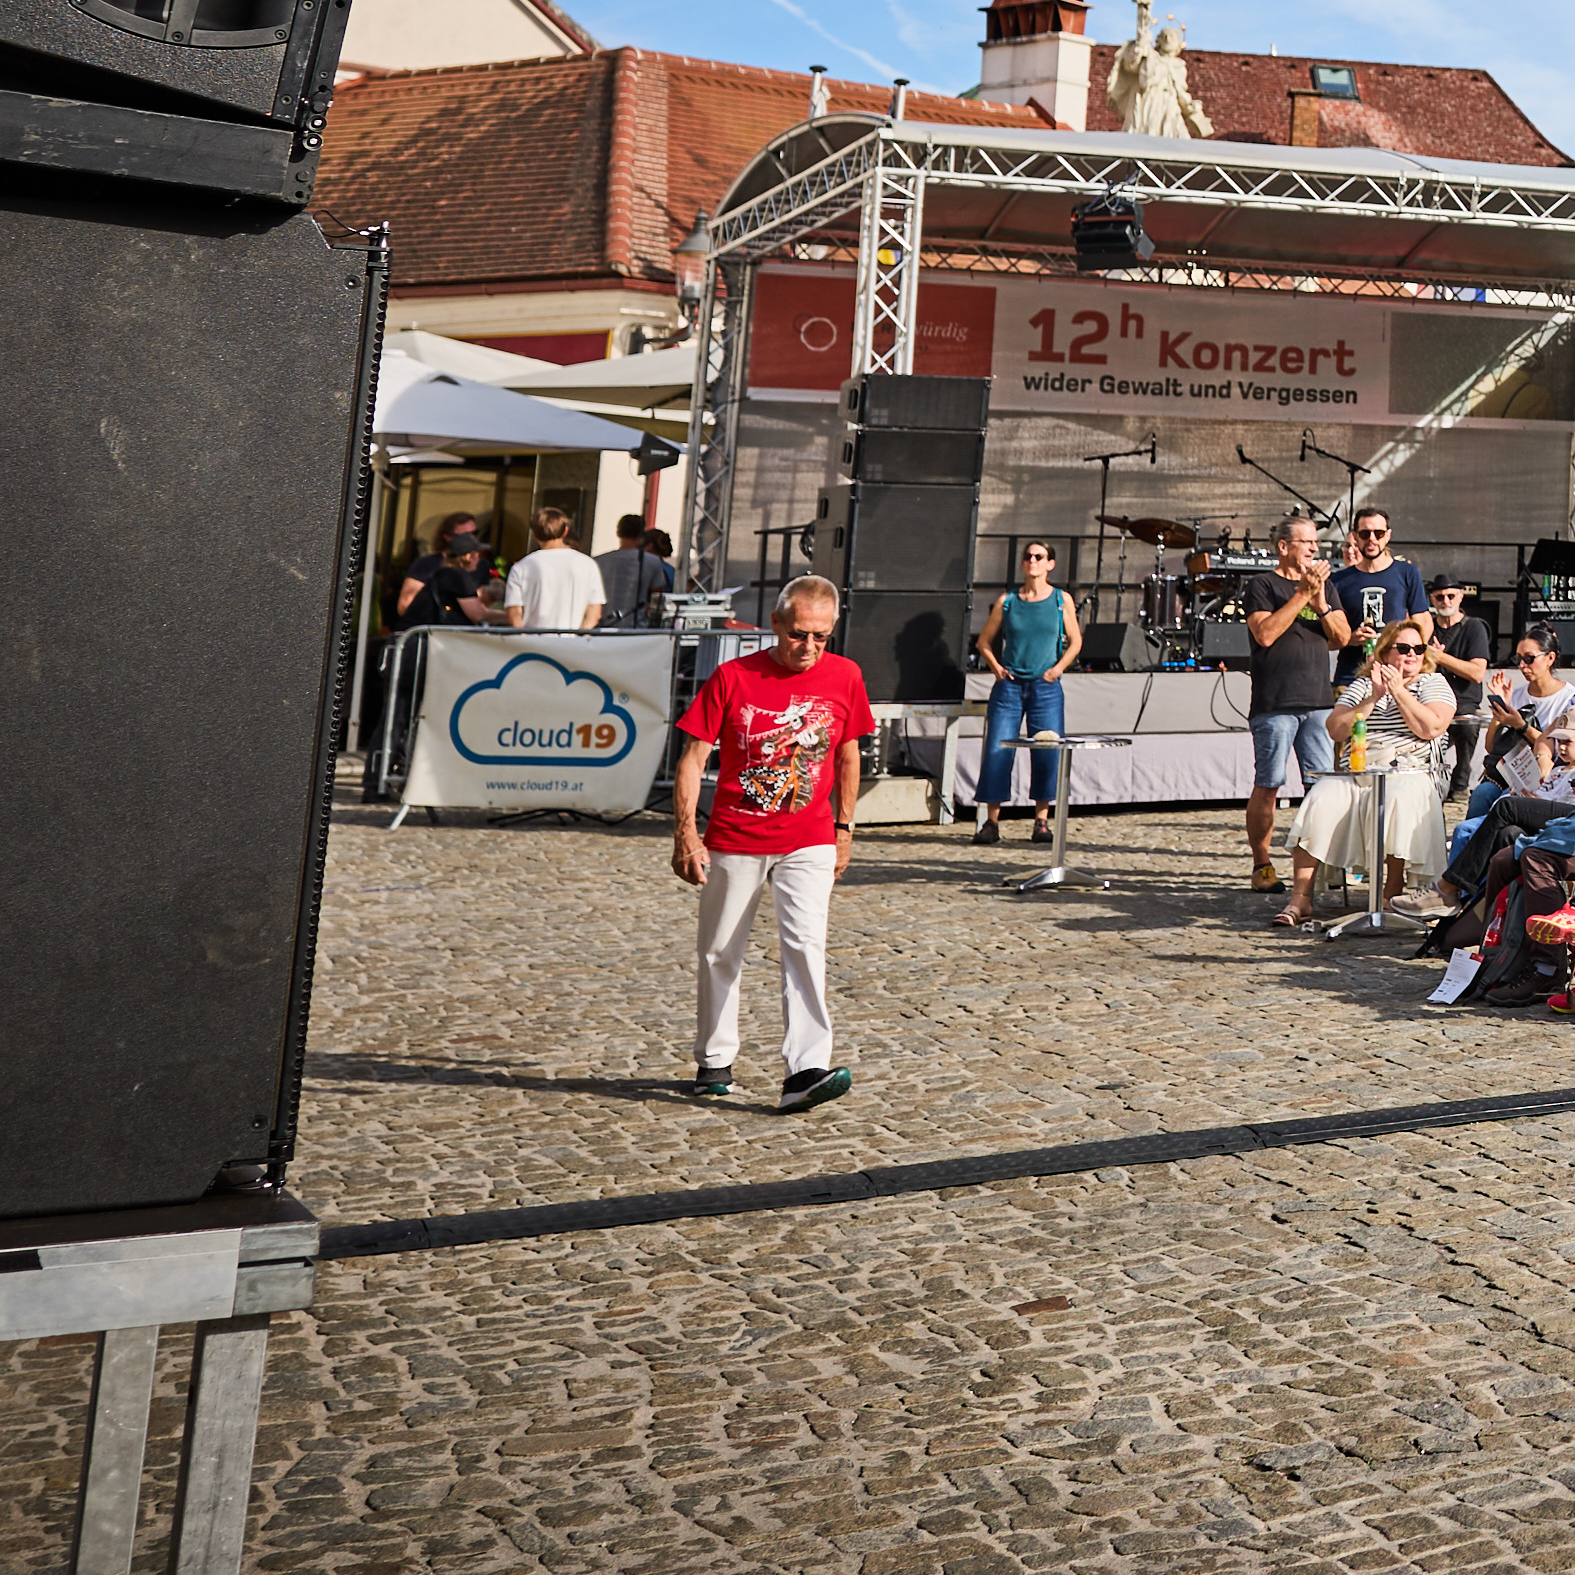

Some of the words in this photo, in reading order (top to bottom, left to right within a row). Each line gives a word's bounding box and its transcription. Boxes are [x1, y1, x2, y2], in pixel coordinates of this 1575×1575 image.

[1158, 330, 1357, 377] Konzert
[1023, 372, 1092, 393] wider
[1099, 375, 1183, 397] Gewalt
[1189, 380, 1232, 399] und
[1237, 381, 1358, 406] Vergessen
[497, 721, 617, 749] cloud19
[486, 779, 584, 792] www.cloud19.at
